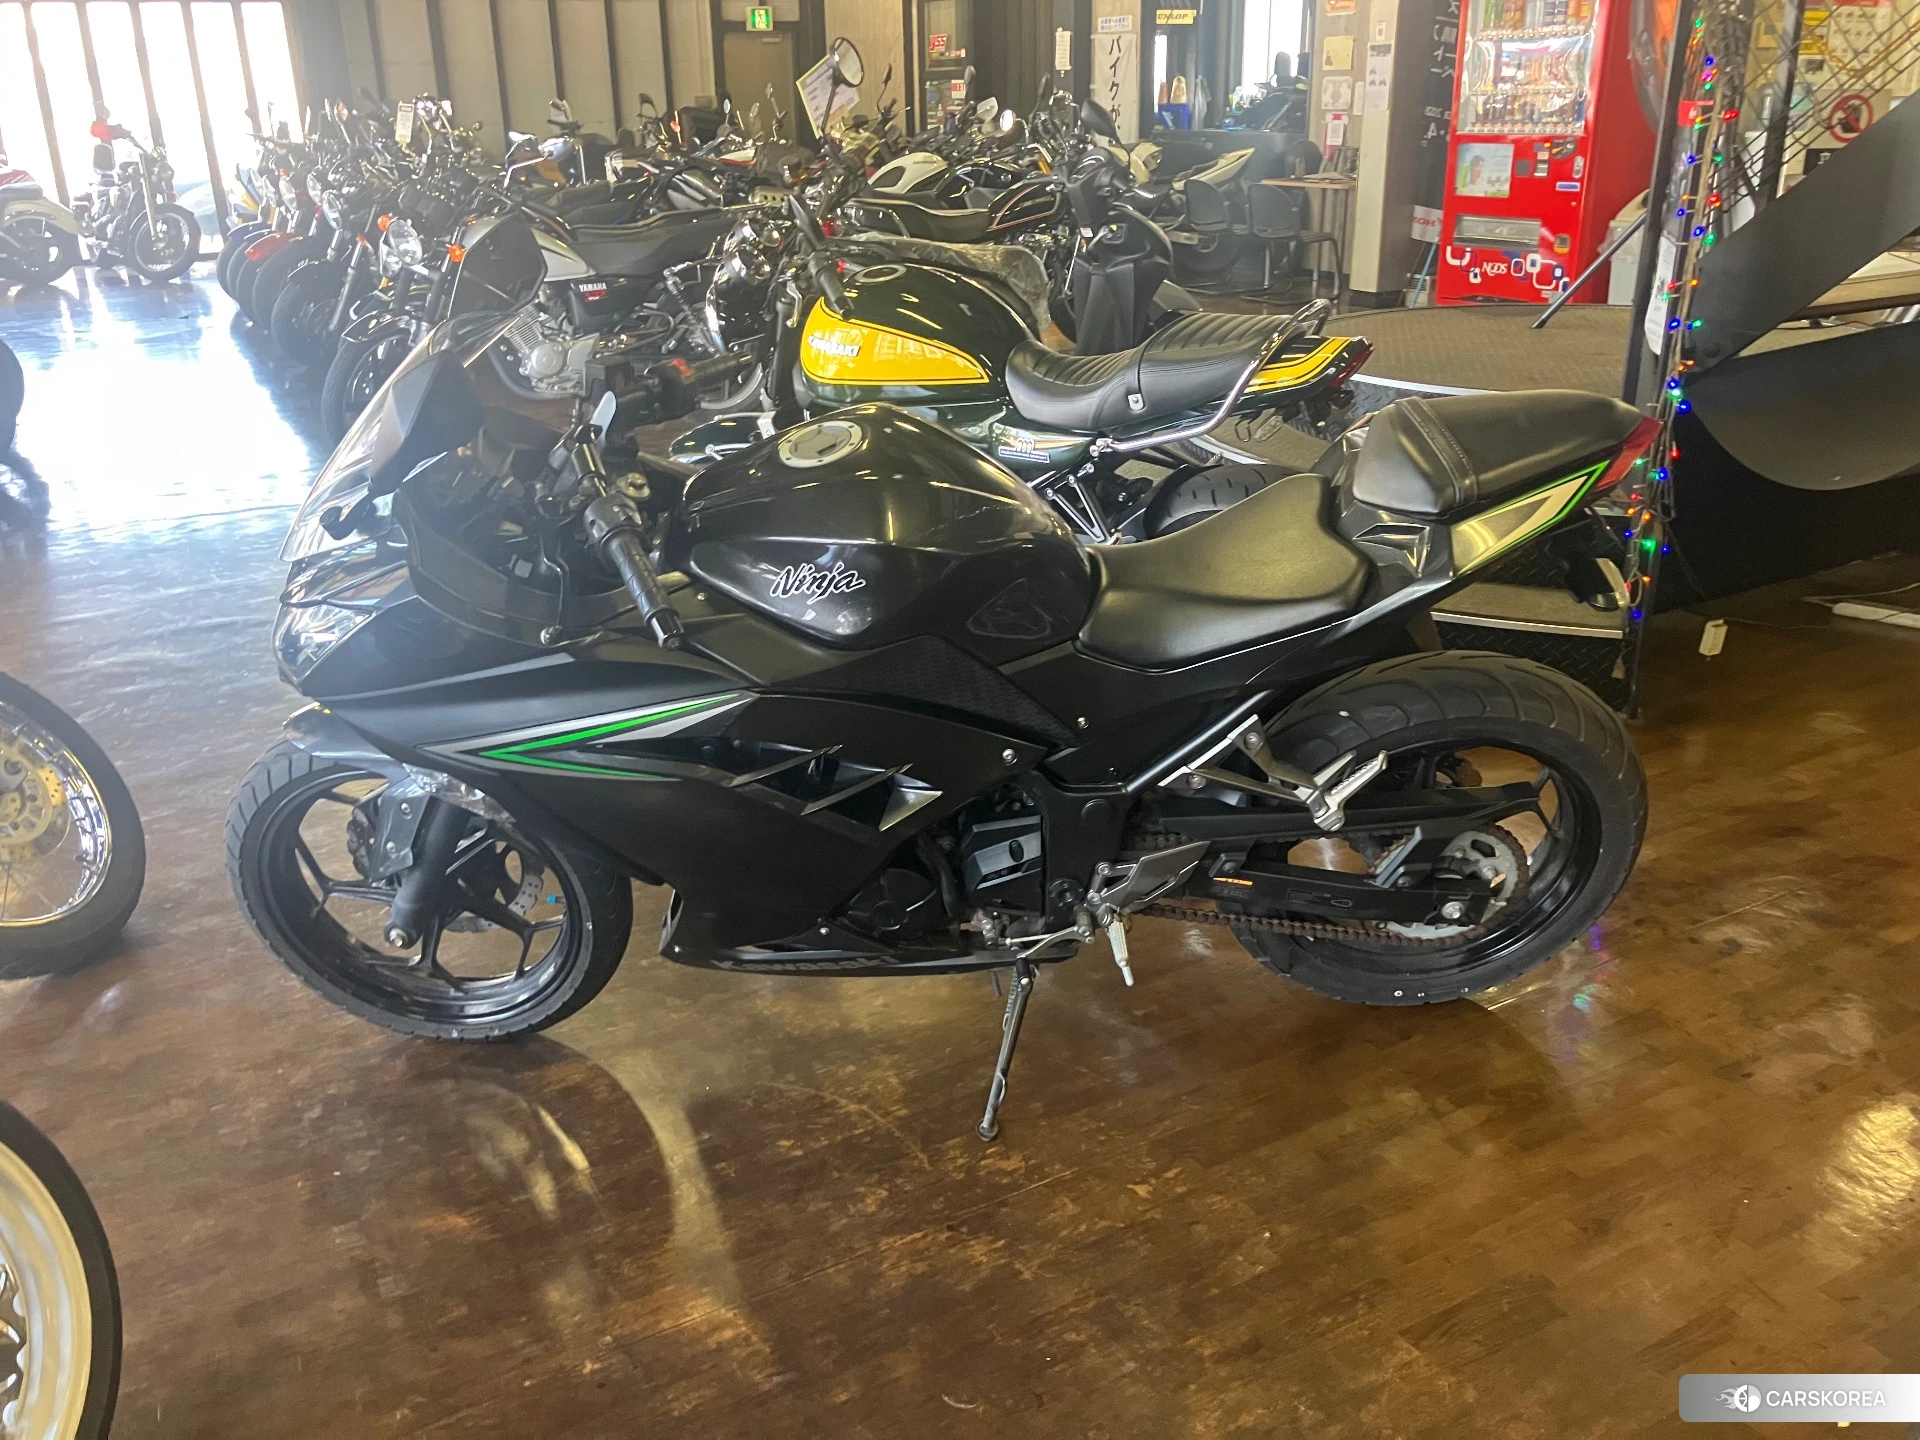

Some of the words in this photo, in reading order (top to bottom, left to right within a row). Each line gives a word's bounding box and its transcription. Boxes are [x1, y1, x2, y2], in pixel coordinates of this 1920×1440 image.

[1108, 35, 1121, 147] バイクが、
[578, 282, 607, 293] YAMAHA
[769, 561, 867, 605] Ninja
[710, 955, 899, 971] Kawasaki
